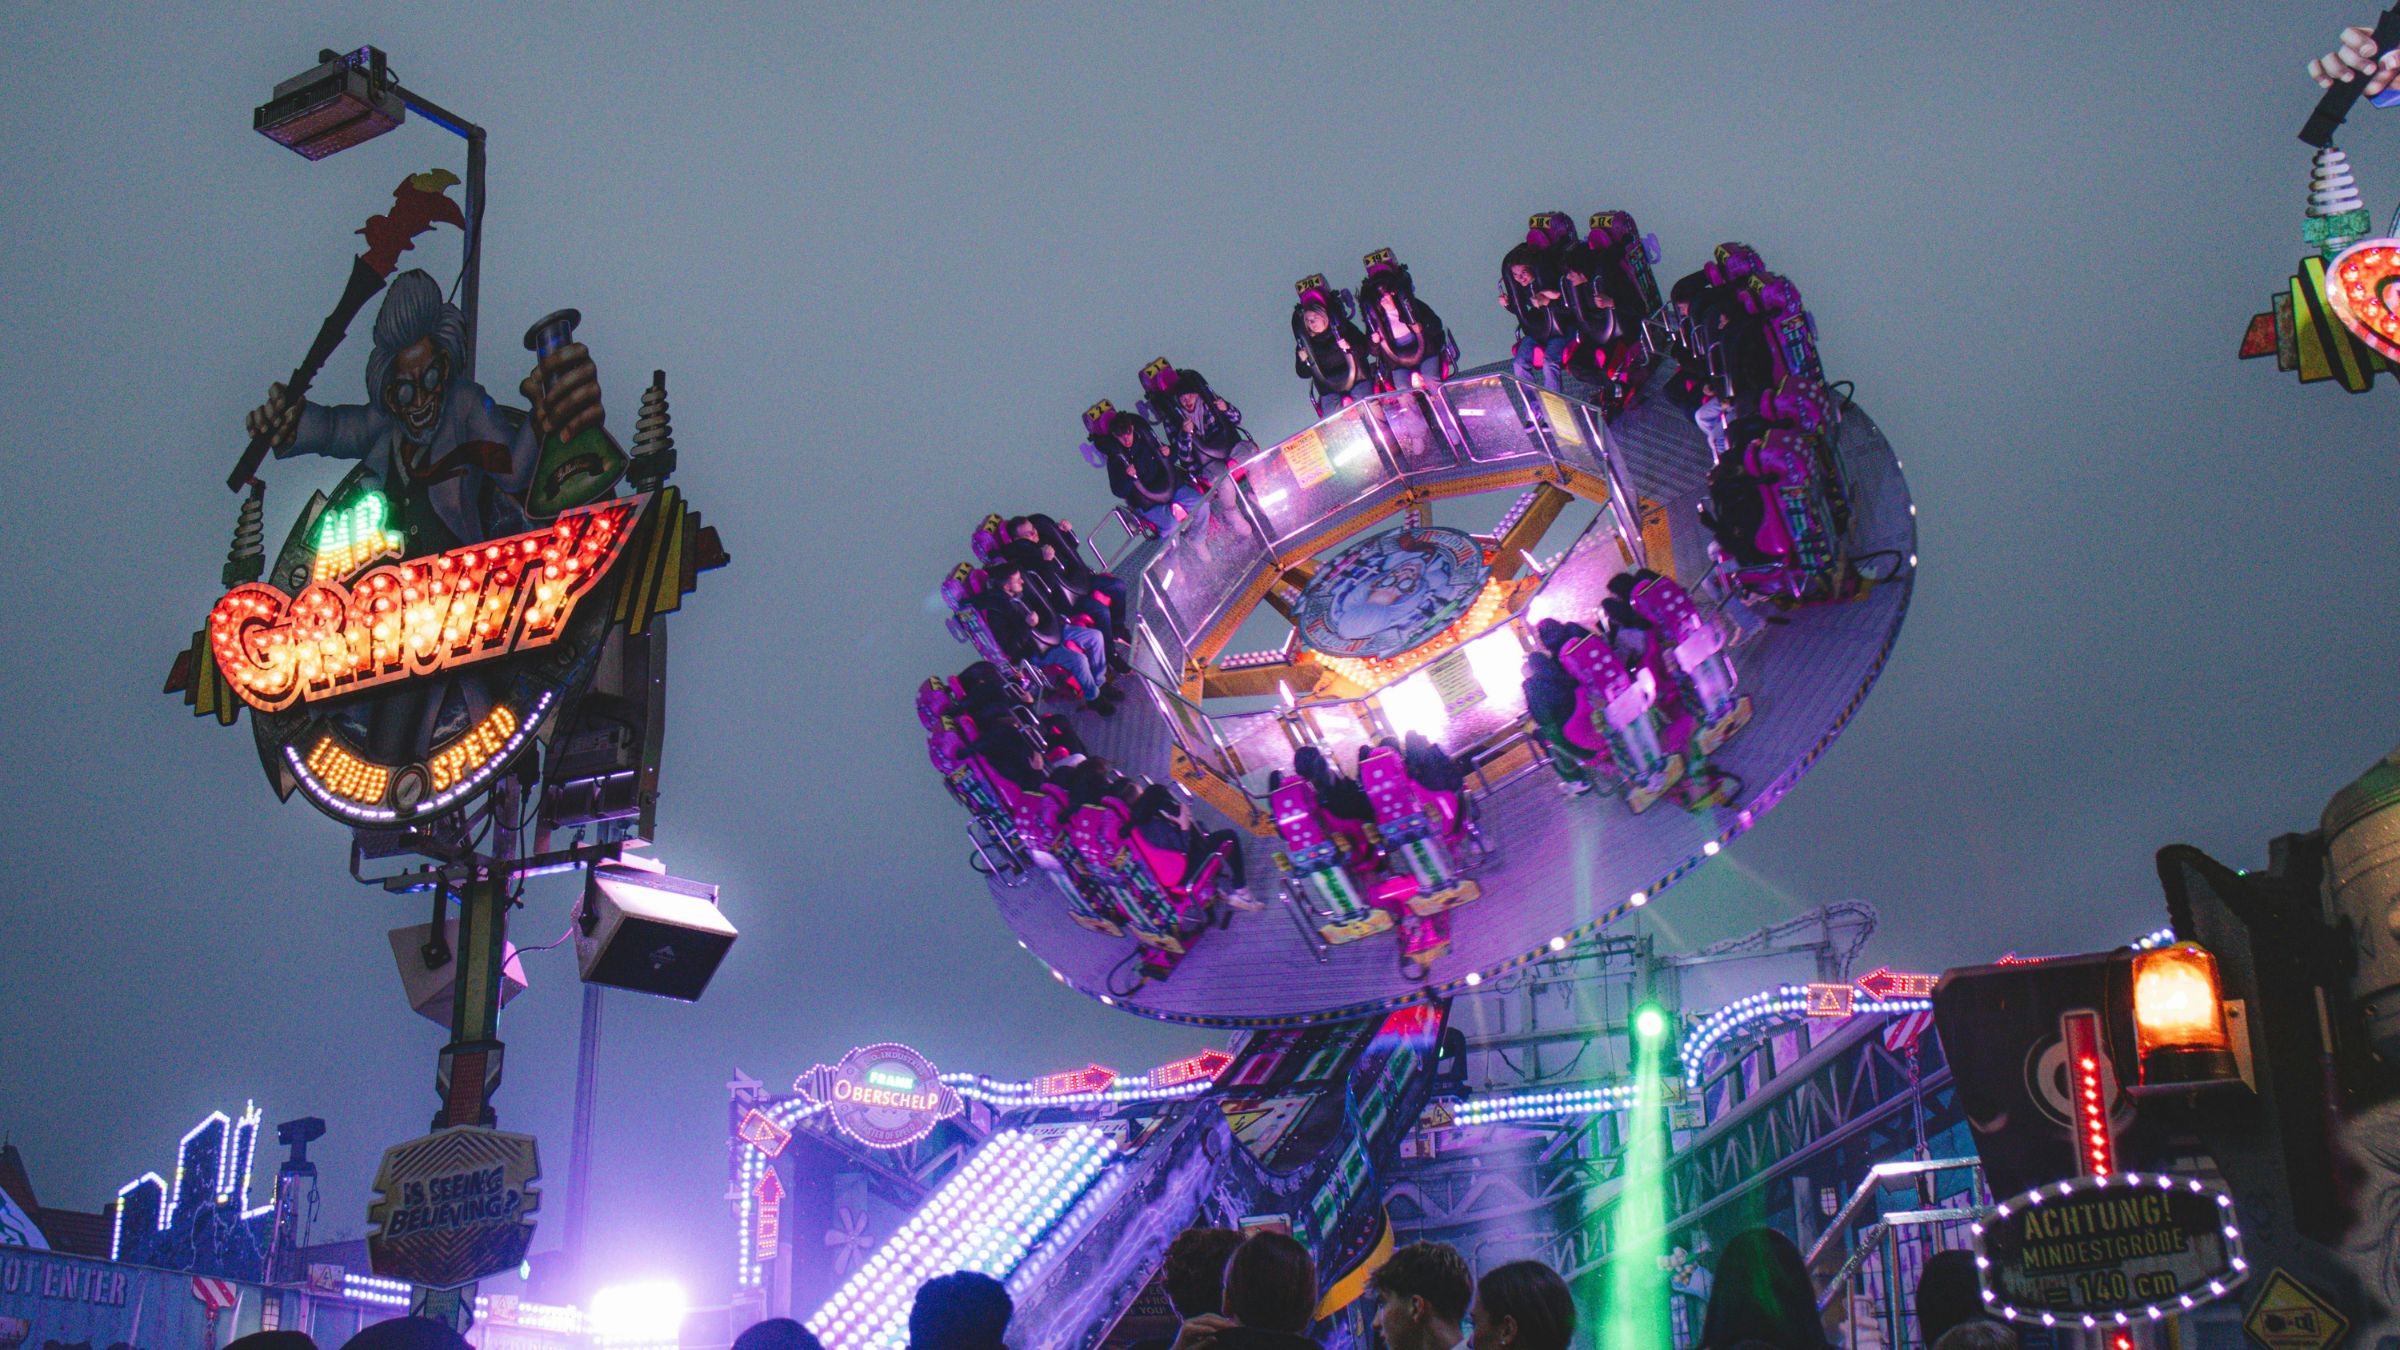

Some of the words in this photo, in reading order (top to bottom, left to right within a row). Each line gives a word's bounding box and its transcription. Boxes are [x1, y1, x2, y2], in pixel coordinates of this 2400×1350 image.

[210, 500, 642, 698] GRAVITY
[431, 704, 518, 793] SPEED
[834, 1079, 939, 1110] OBERSCHELP
[869, 1070, 915, 1090] FRANK
[403, 1179, 425, 1205] IS
[428, 1165, 504, 1202] SEEING
[386, 1189, 520, 1237] BELIEVING?
[2024, 1192, 2173, 1241] ACHTUNG!
[43, 1260, 128, 1306] ENTER
[2079, 1270, 2127, 1303] 140
[2135, 1271, 2177, 1299] cm
